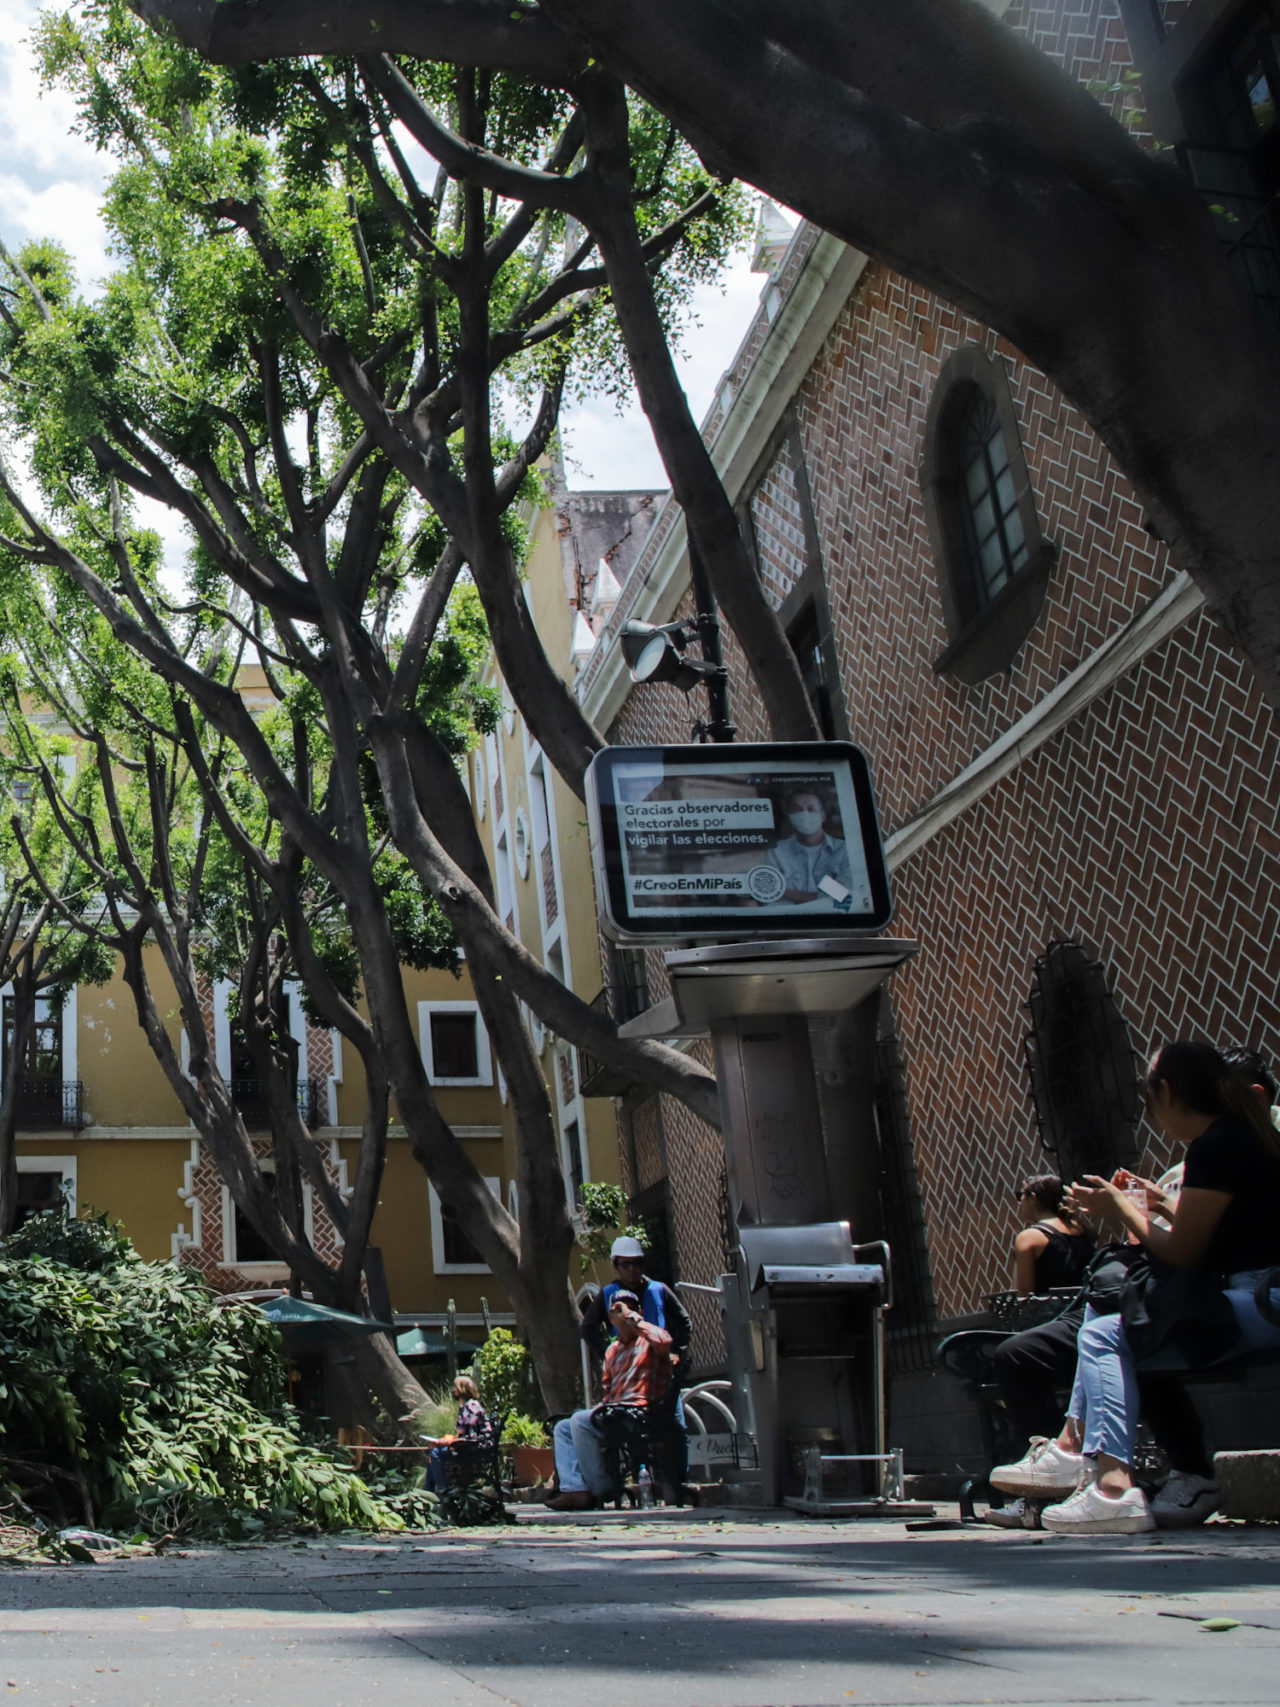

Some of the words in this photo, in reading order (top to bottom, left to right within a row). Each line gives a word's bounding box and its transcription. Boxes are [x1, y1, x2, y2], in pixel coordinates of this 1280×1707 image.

[624, 804, 674, 816] Gracias
[677, 801, 770, 814] observadores
[626, 816, 699, 829] electorales
[703, 818, 726, 831] por
[628, 833, 669, 848] vigilar
[672, 833, 692, 845] las
[695, 832, 769, 844] elecciones.
